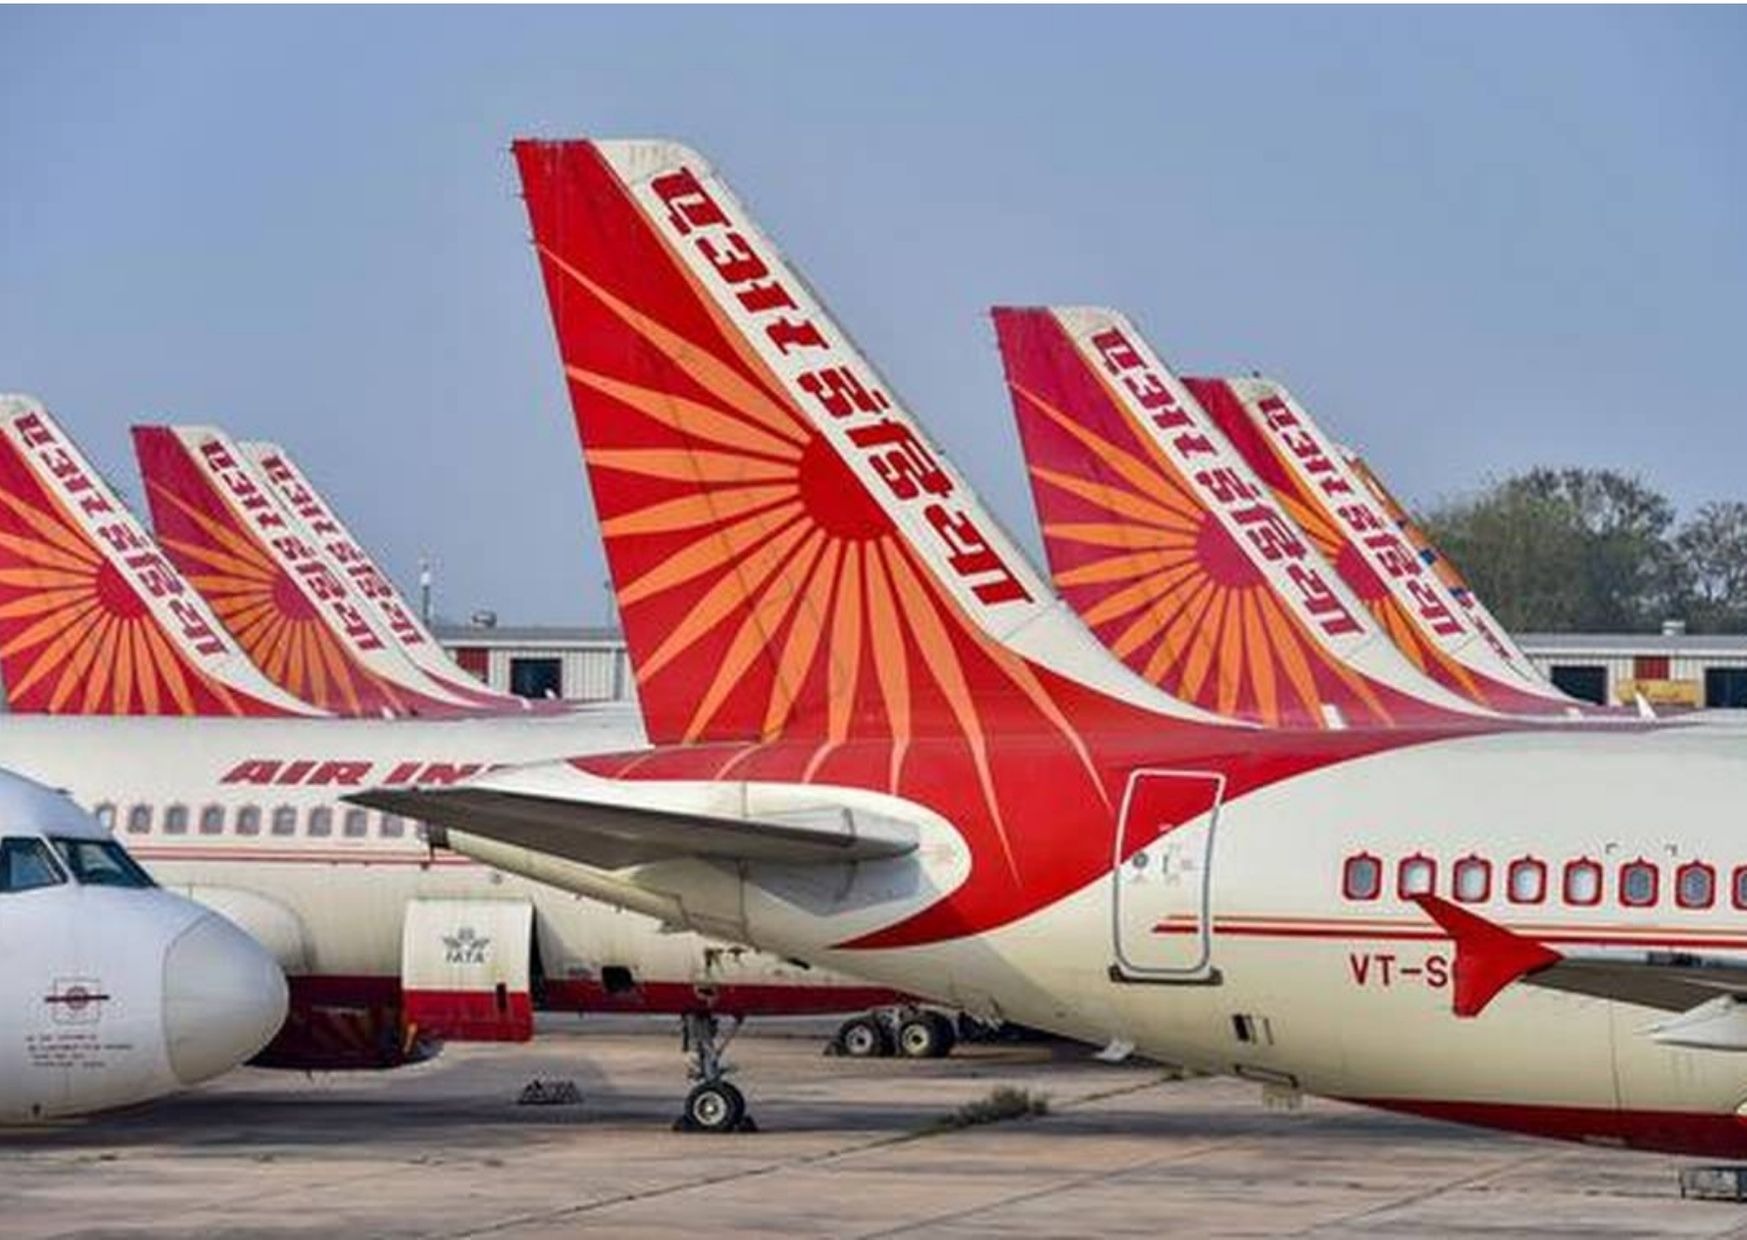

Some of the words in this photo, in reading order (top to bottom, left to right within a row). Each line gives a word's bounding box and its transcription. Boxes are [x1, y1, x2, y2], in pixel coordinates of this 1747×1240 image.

[220, 761, 374, 785] AIR
[381, 763, 517, 785] IN
[446, 951, 484, 963] IATA
[1350, 953, 1456, 988] VT-S
